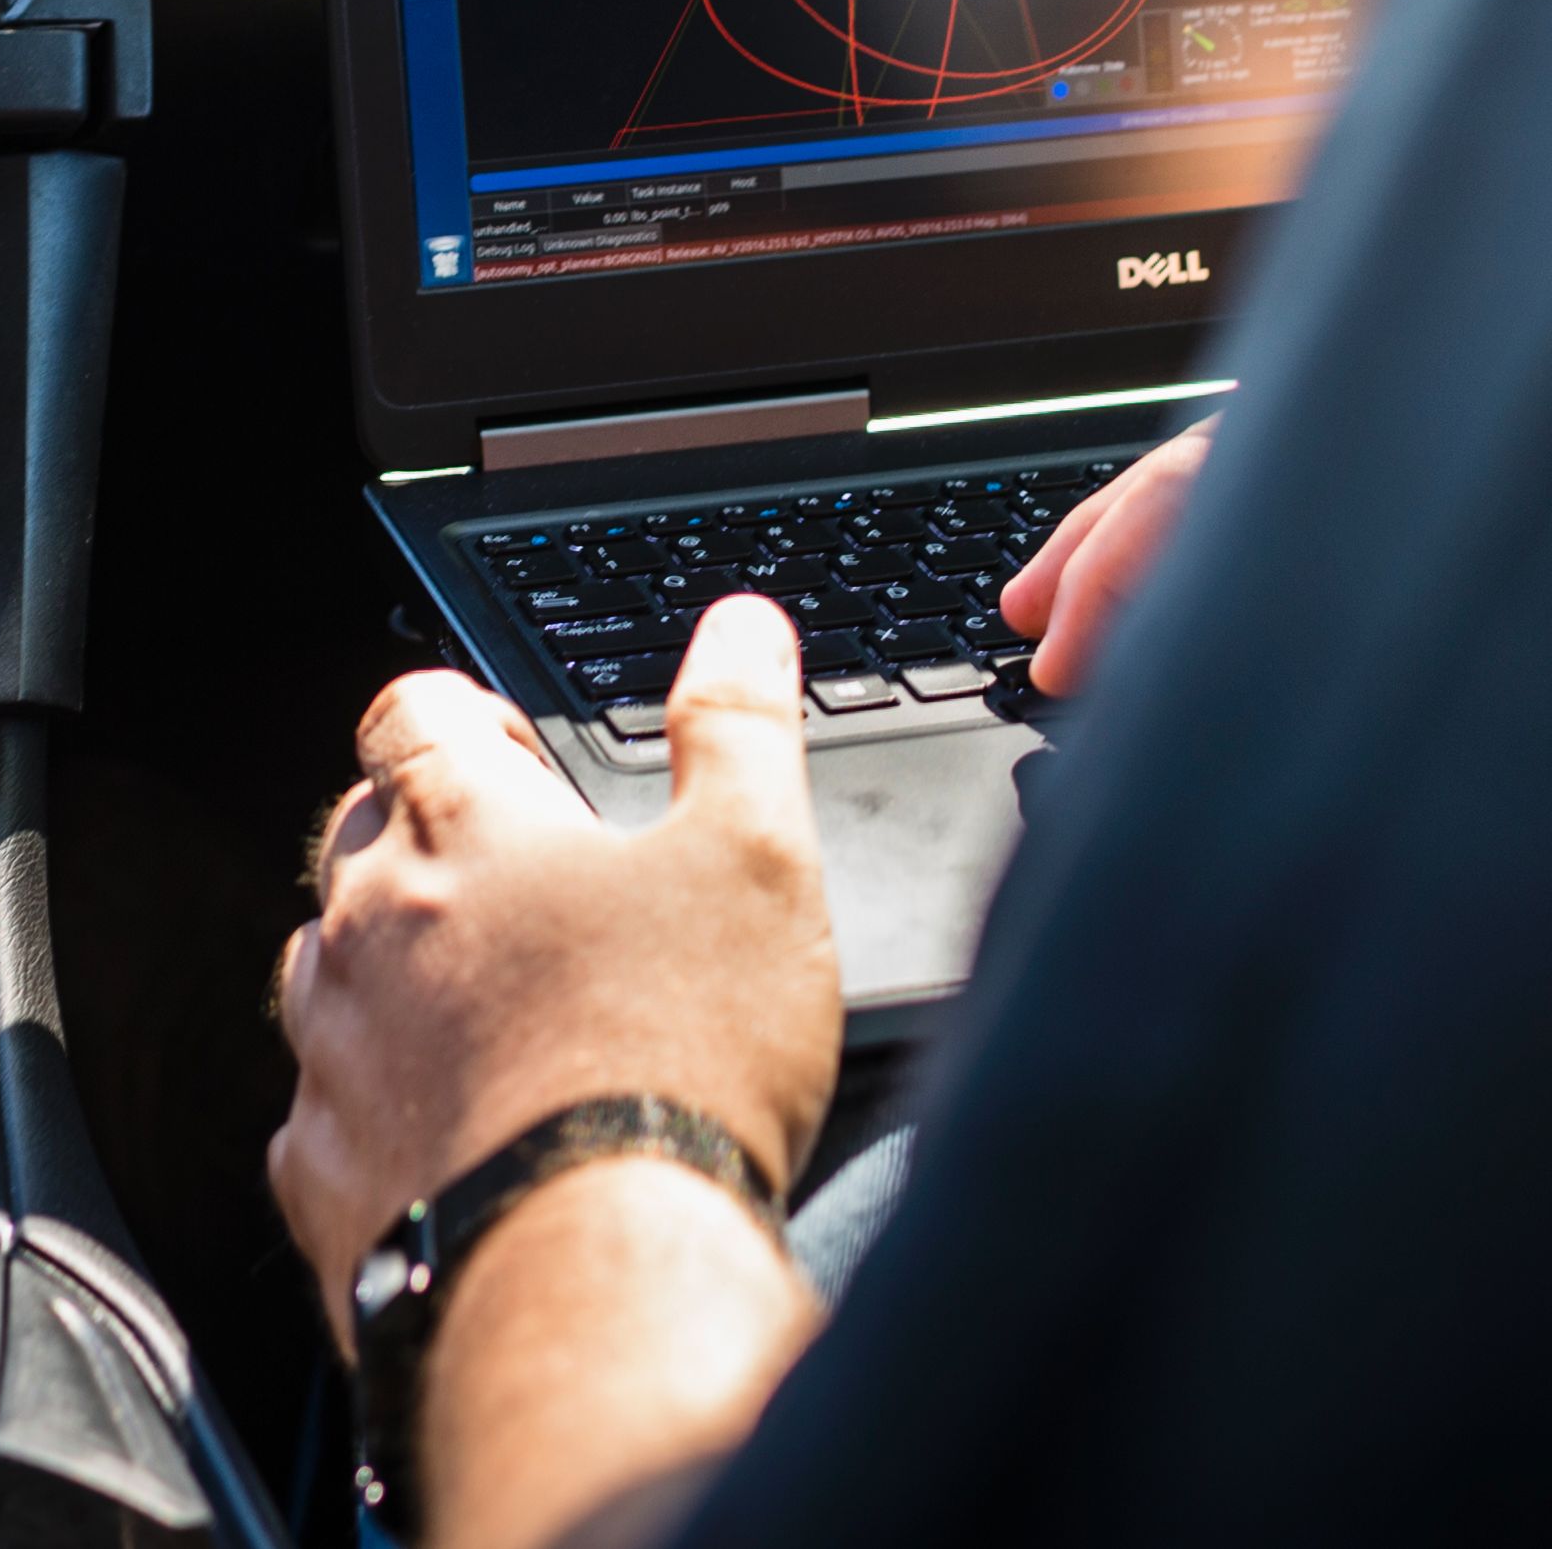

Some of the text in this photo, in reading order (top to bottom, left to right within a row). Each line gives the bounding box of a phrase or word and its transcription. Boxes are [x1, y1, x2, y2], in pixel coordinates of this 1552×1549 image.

[731, 176, 758, 190] Host
[573, 191, 604, 205] Value
[632, 182, 702, 200] Task Instance
[494, 200, 527, 213] Name
[543, 230, 658, 252] Unknown Diagnostics
[476, 241, 536, 259] Debug Log
[1117, 249, 1210, 289] DELL
[925, 543, 947, 555] R
[839, 553, 860, 566] E
[747, 563, 776, 577] W
[663, 575, 687, 588] Q
[886, 586, 910, 599] D
[799, 596, 820, 610] S
[965, 616, 988, 629] C
[874, 627, 900, 642] X
